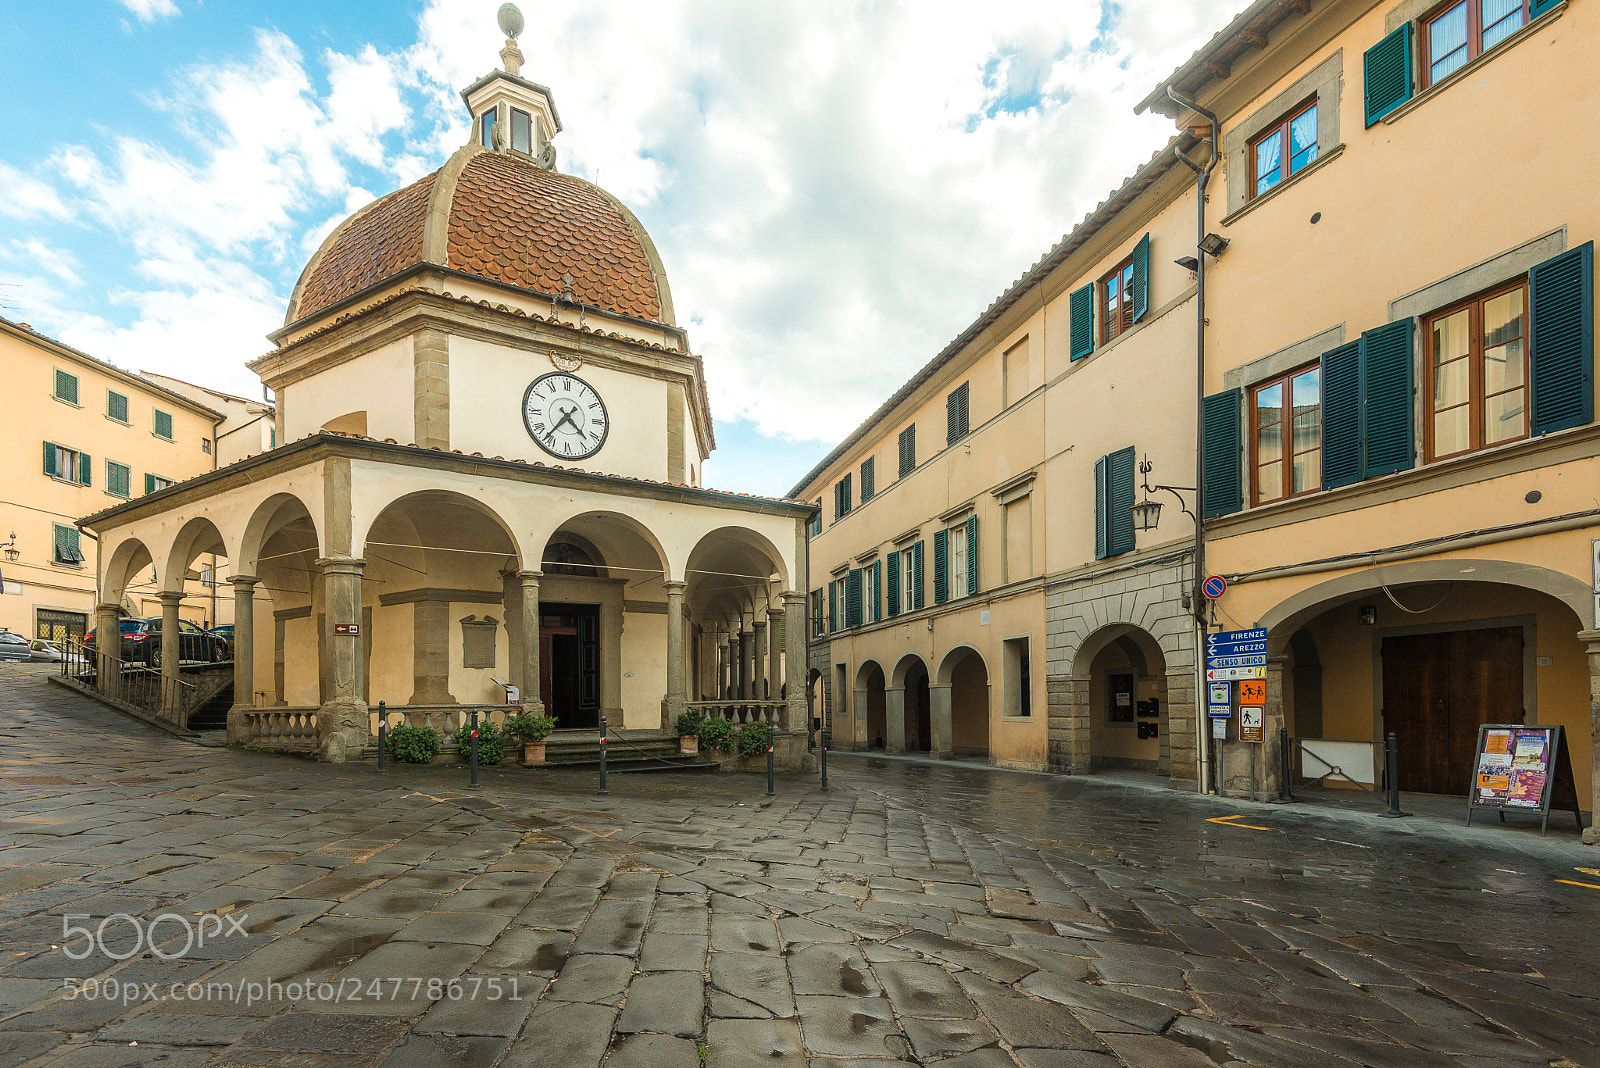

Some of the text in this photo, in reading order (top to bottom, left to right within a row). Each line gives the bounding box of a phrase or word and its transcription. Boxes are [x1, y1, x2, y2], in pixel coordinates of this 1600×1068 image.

[1230, 630, 1265, 640] FIRENZE
[1233, 643, 1265, 652] AREZZO
[1217, 656, 1263, 667] SENSO UNICO
